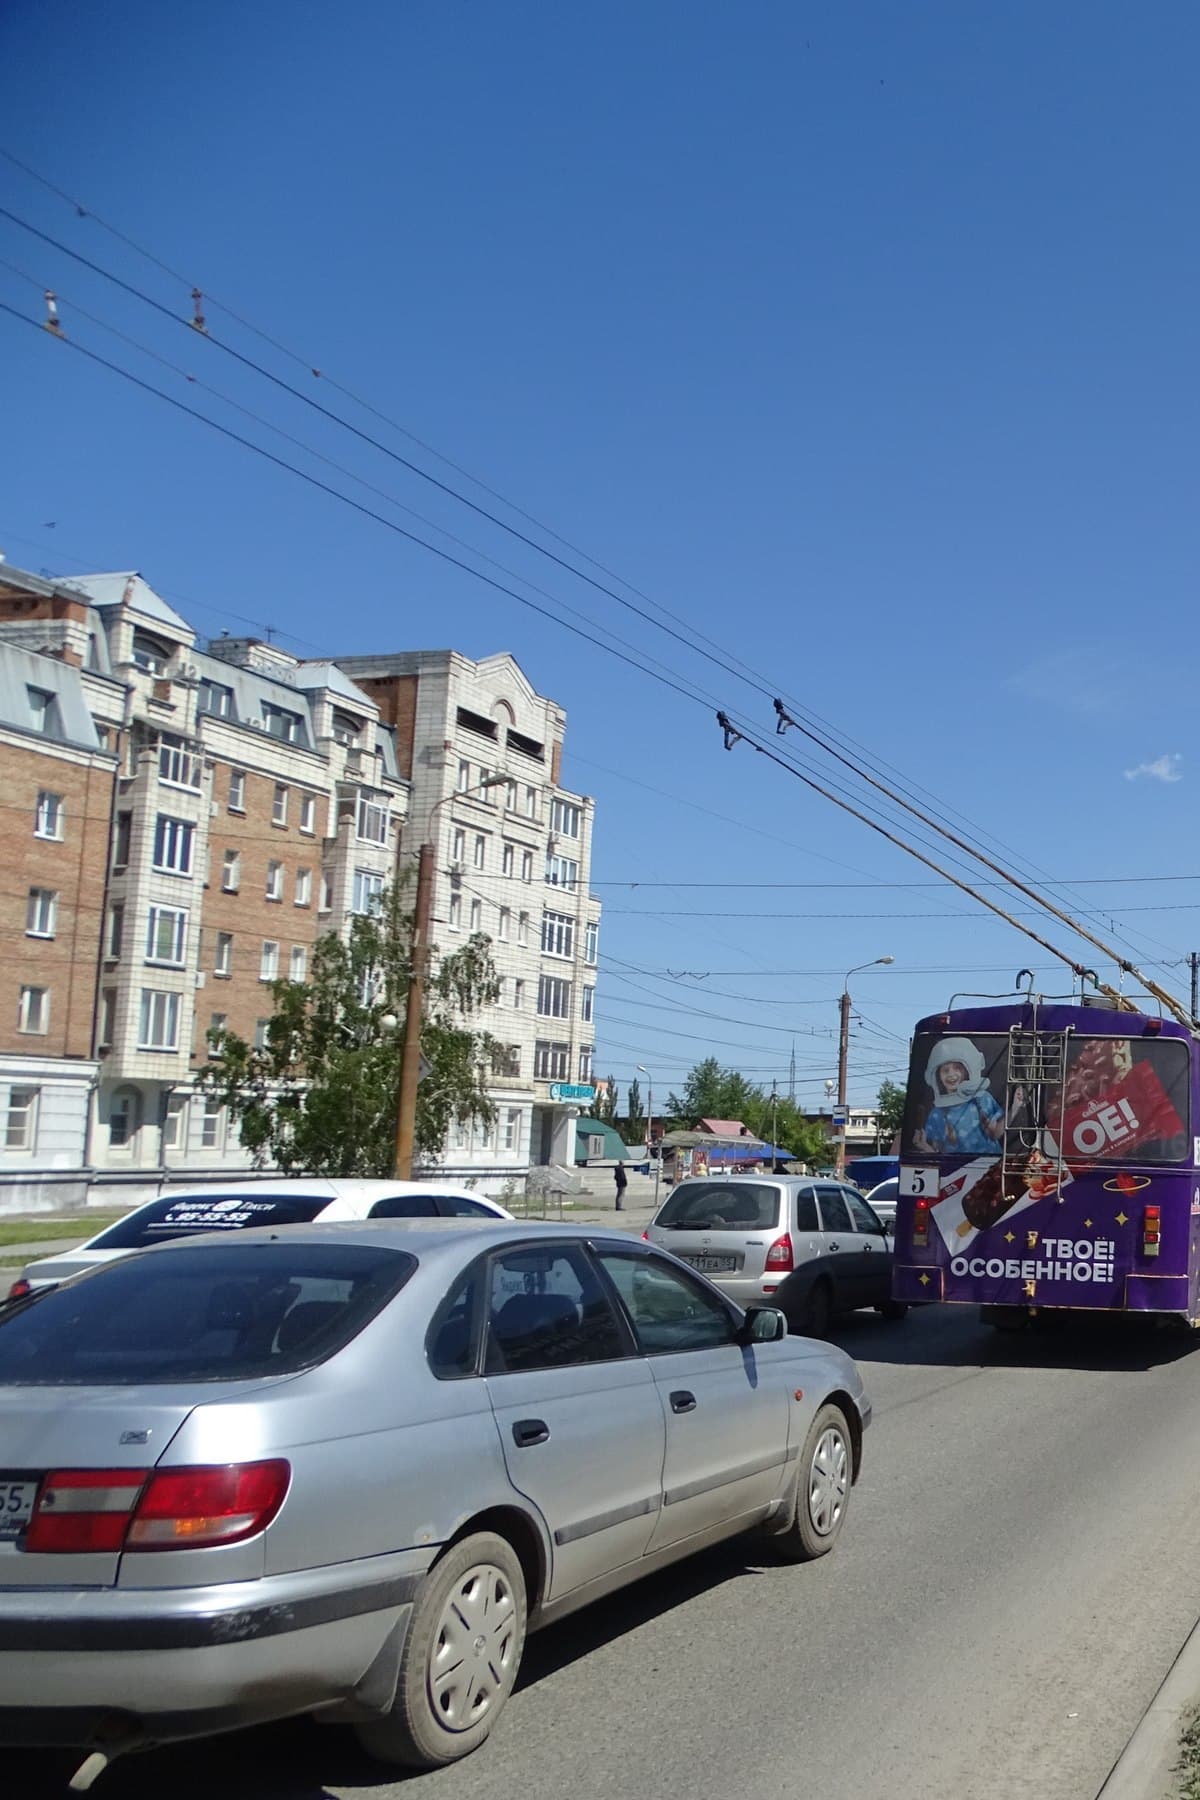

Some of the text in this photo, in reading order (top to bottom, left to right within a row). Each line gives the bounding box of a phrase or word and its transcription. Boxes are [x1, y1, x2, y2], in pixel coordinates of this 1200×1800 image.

[911, 1169, 925, 1194] 5
[1042, 1236, 1115, 1261] ТВОЁ!
[950, 1257, 1114, 1283] ОСОБЕННОЕ!
